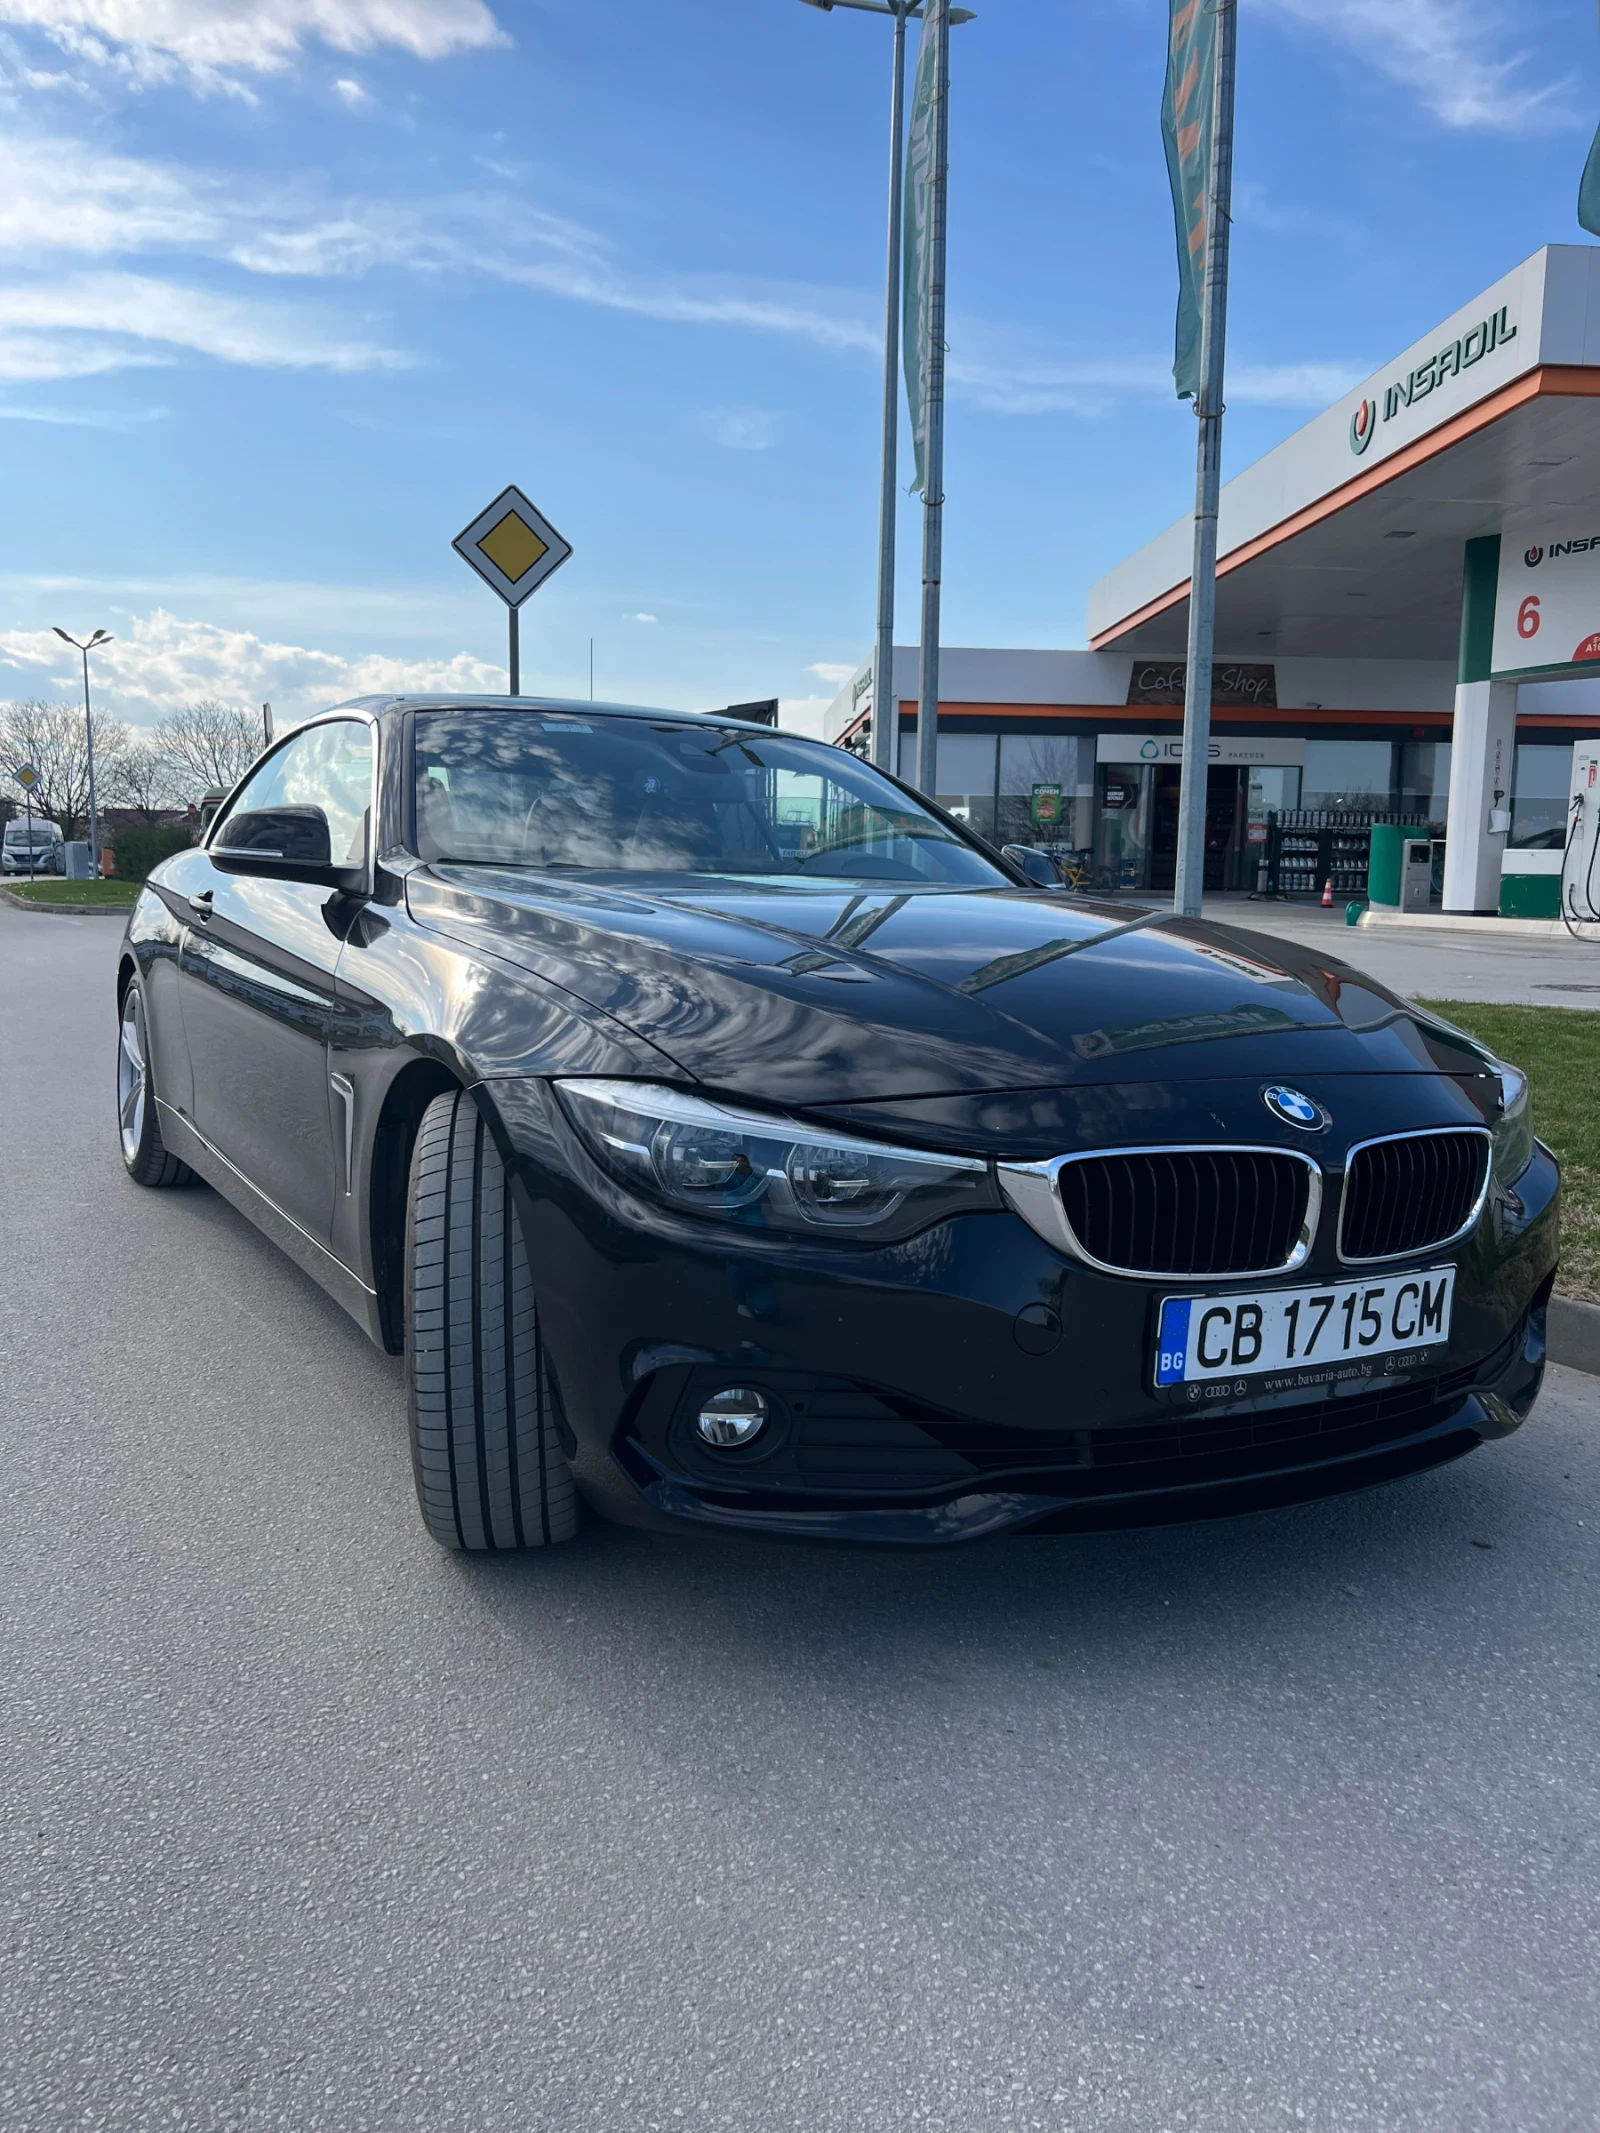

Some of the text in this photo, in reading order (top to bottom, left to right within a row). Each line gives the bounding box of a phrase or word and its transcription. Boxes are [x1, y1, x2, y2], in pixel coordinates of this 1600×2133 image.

[1383, 305, 1517, 422] INSAOIL
[1517, 595, 1540, 639] 6
[1221, 669, 1269, 702] Shop
[1197, 1303, 1263, 1369] CB
[1160, 1352, 1183, 1371] BG
[1264, 1364, 1373, 1390] www.bavaria-auto.bg
